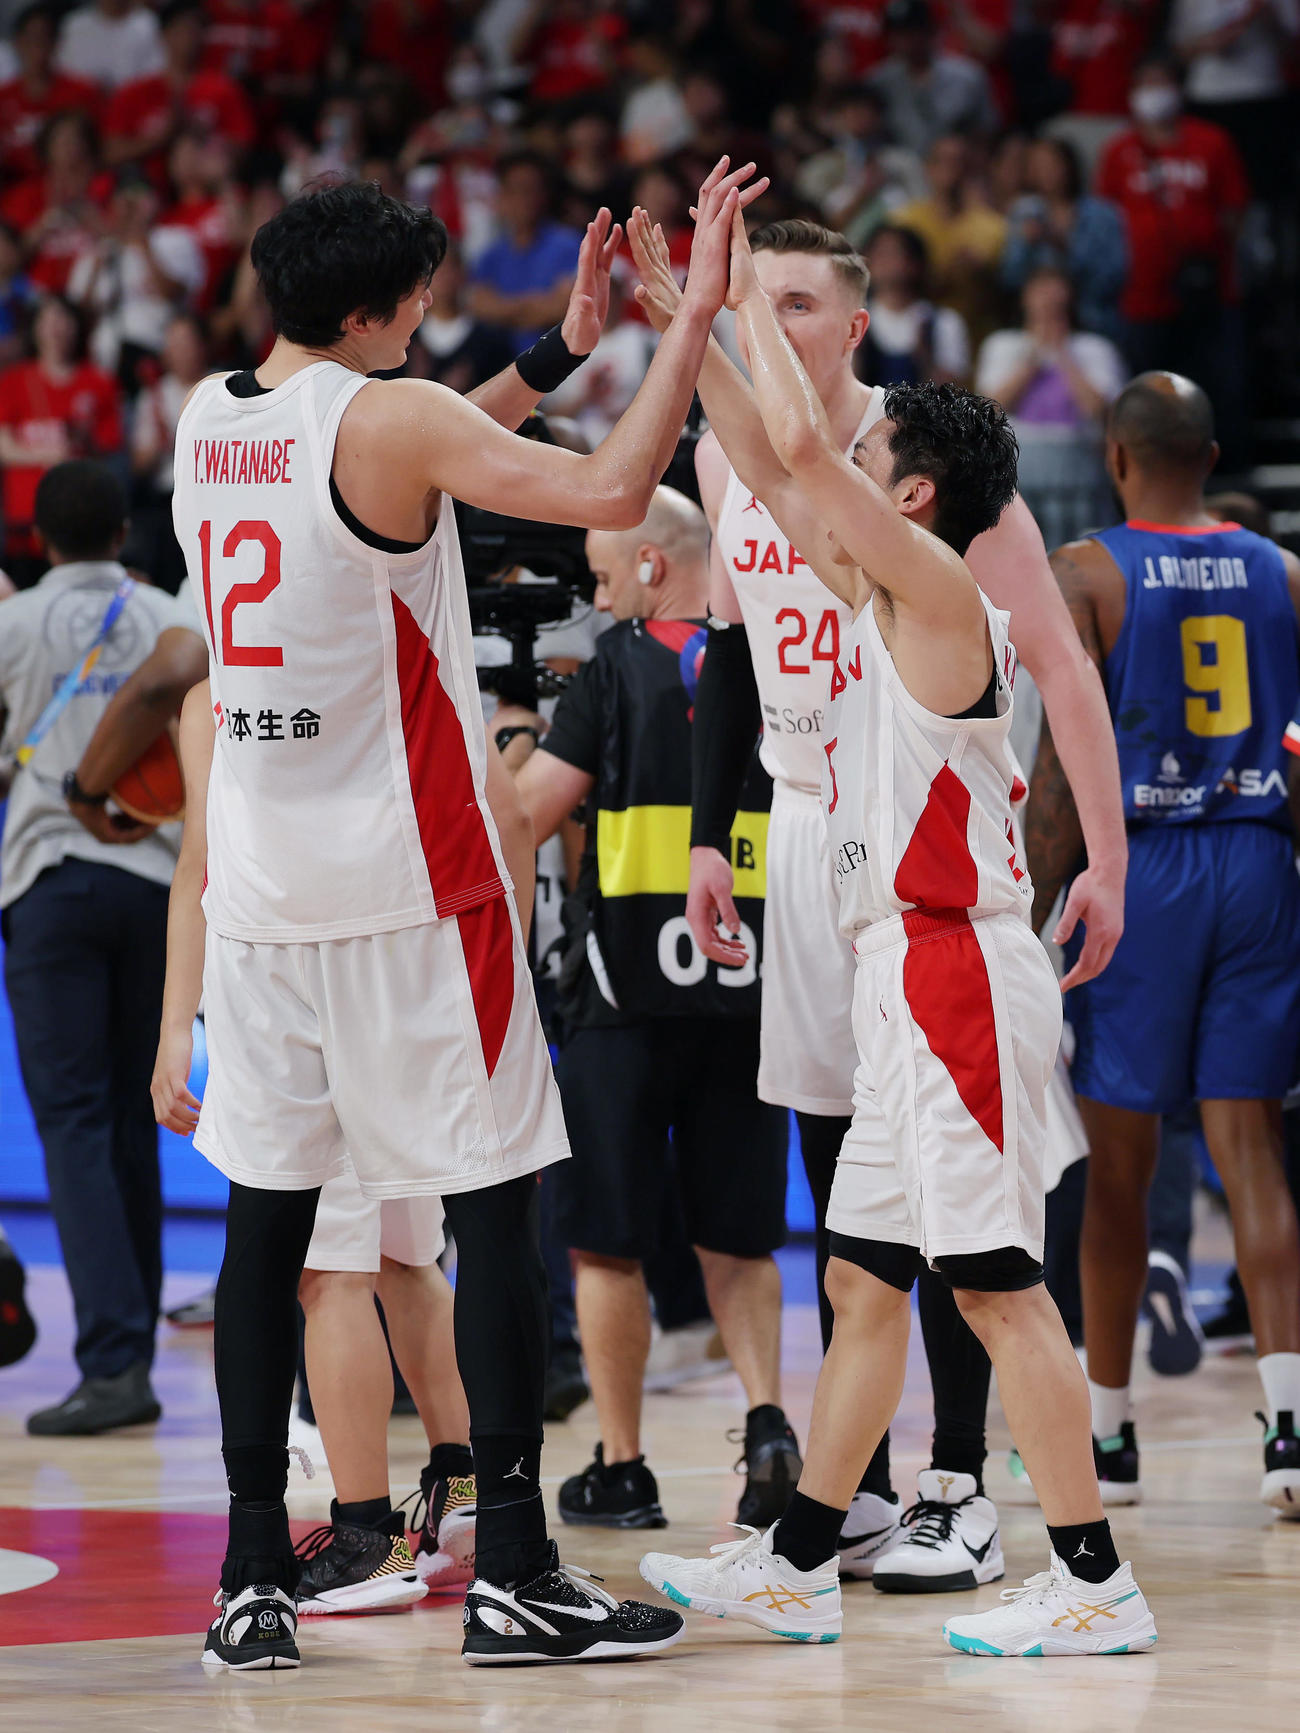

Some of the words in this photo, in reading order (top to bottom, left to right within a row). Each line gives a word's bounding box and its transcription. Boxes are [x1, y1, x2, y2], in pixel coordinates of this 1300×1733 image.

[194, 439, 296, 484] Y.WATANABE
[198, 520, 284, 667] 12
[775, 607, 841, 674] 24
[1180, 614, 1252, 738] 9
[226, 707, 322, 742] 本生命
[782, 708, 824, 735] Sof
[657, 915, 762, 988] 09
[503, 1618, 514, 1635] 2
